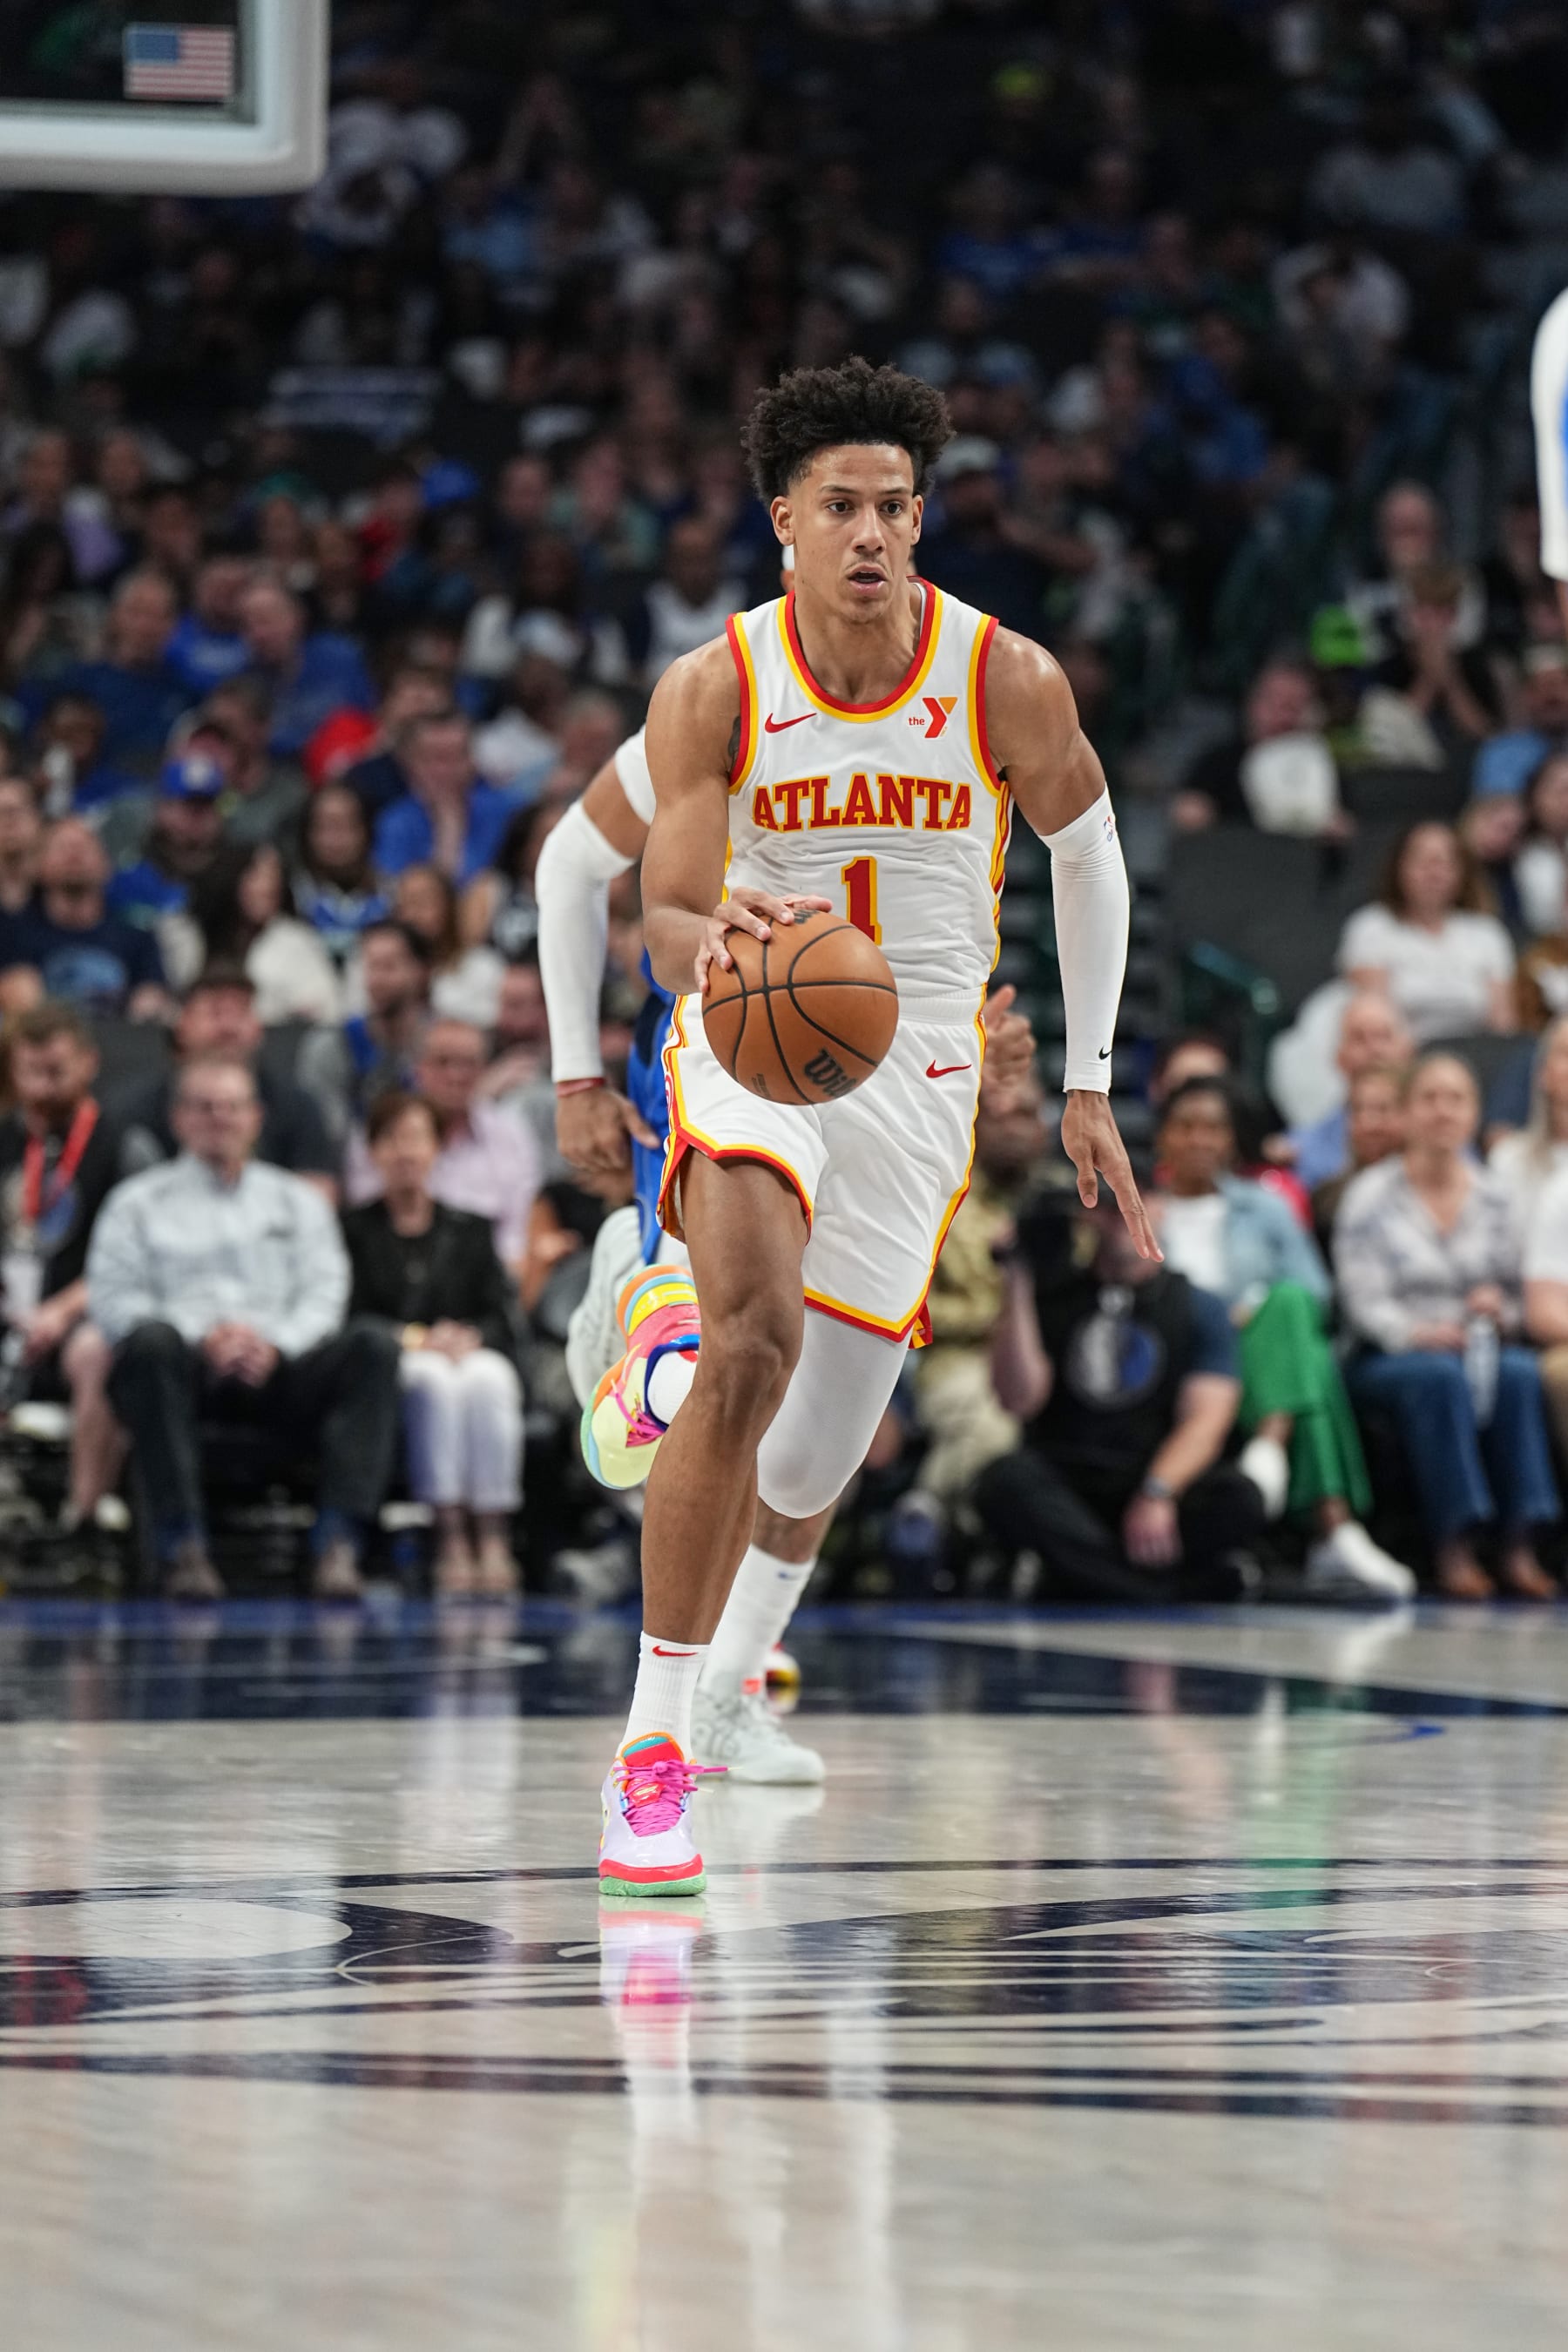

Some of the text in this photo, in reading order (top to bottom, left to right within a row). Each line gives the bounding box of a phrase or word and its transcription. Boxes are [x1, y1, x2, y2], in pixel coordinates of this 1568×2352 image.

[908, 717, 925, 726] the
[753, 773, 971, 833] ATLANTA
[841, 856, 882, 946] 1
